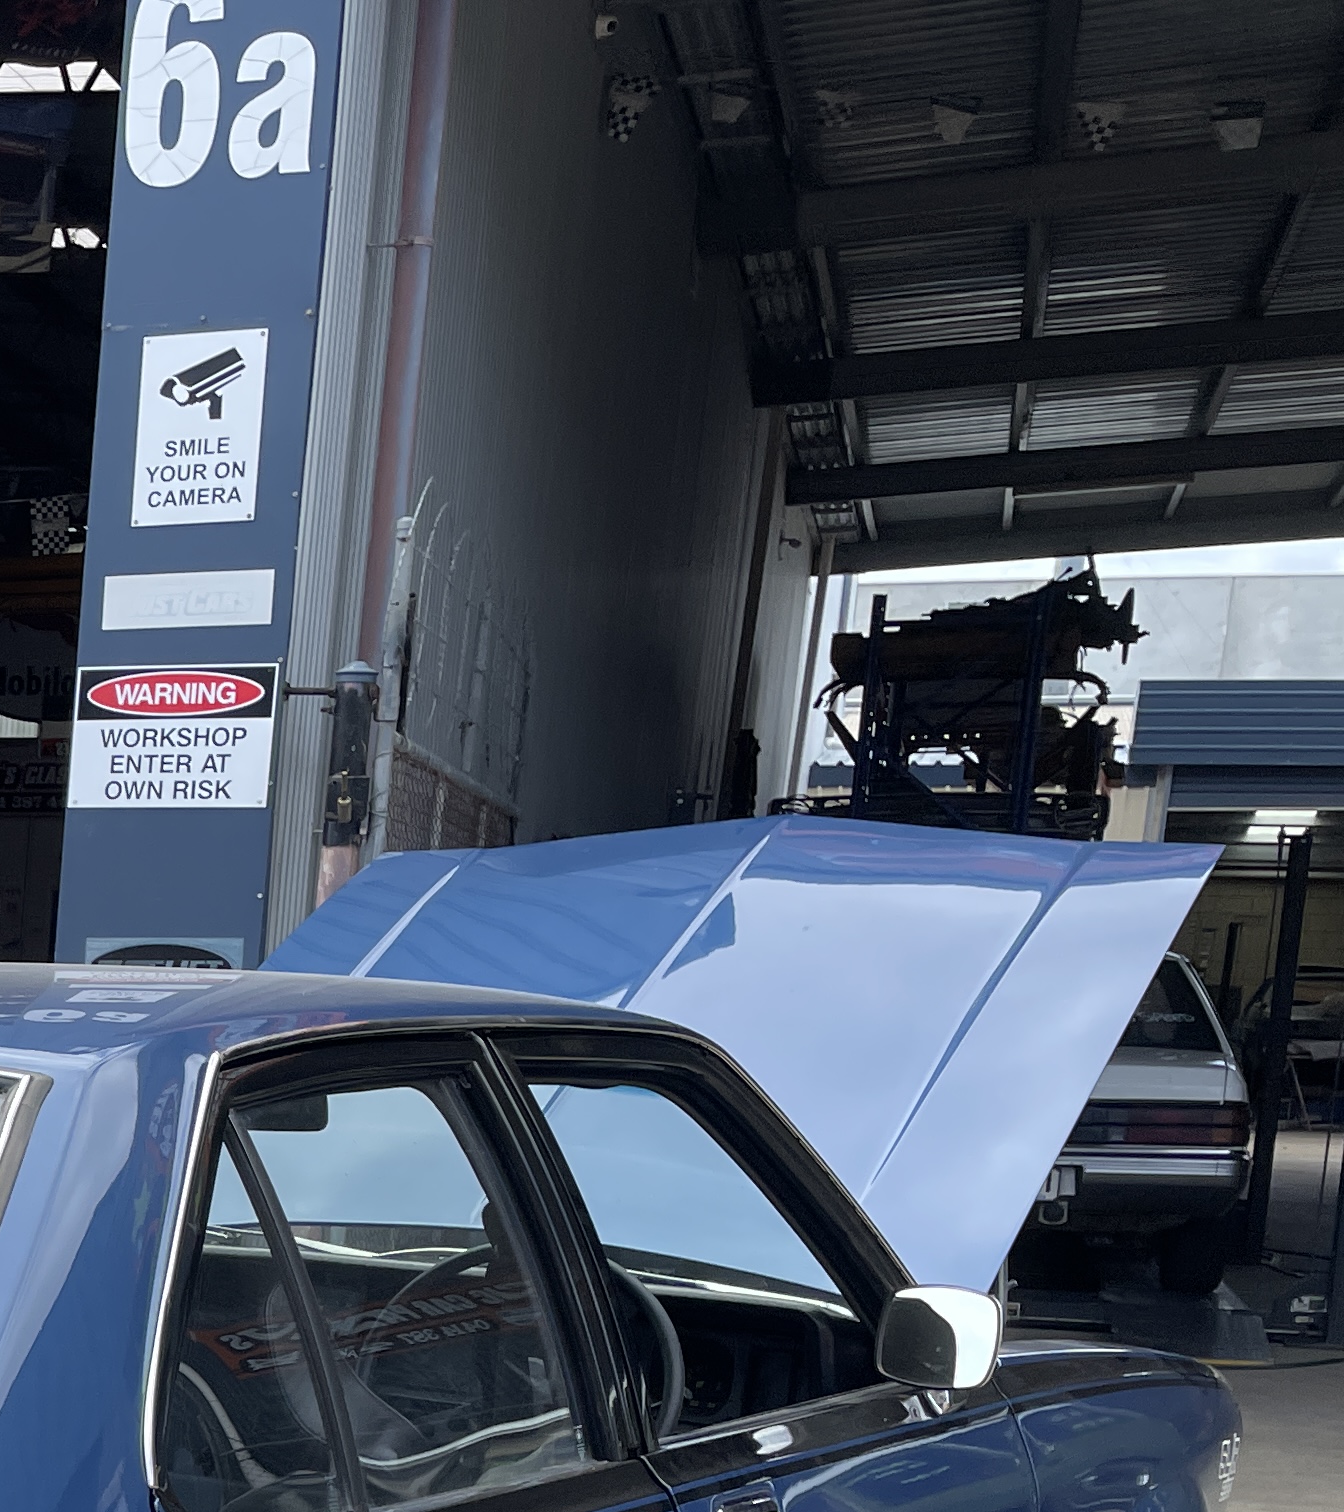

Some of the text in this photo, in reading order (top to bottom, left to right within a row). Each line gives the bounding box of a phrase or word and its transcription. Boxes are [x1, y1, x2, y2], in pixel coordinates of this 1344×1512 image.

[125, 0, 315, 187] 6a
[164, 437, 231, 458] SMILE
[146, 460, 246, 484] YOUR ON
[148, 486, 242, 509] CAMERA
[115, 681, 237, 706] WARNING
[101, 727, 248, 748] WORKSHOP
[110, 753, 232, 774] ENTER AT
[105, 779, 233, 800] OWN RISK
